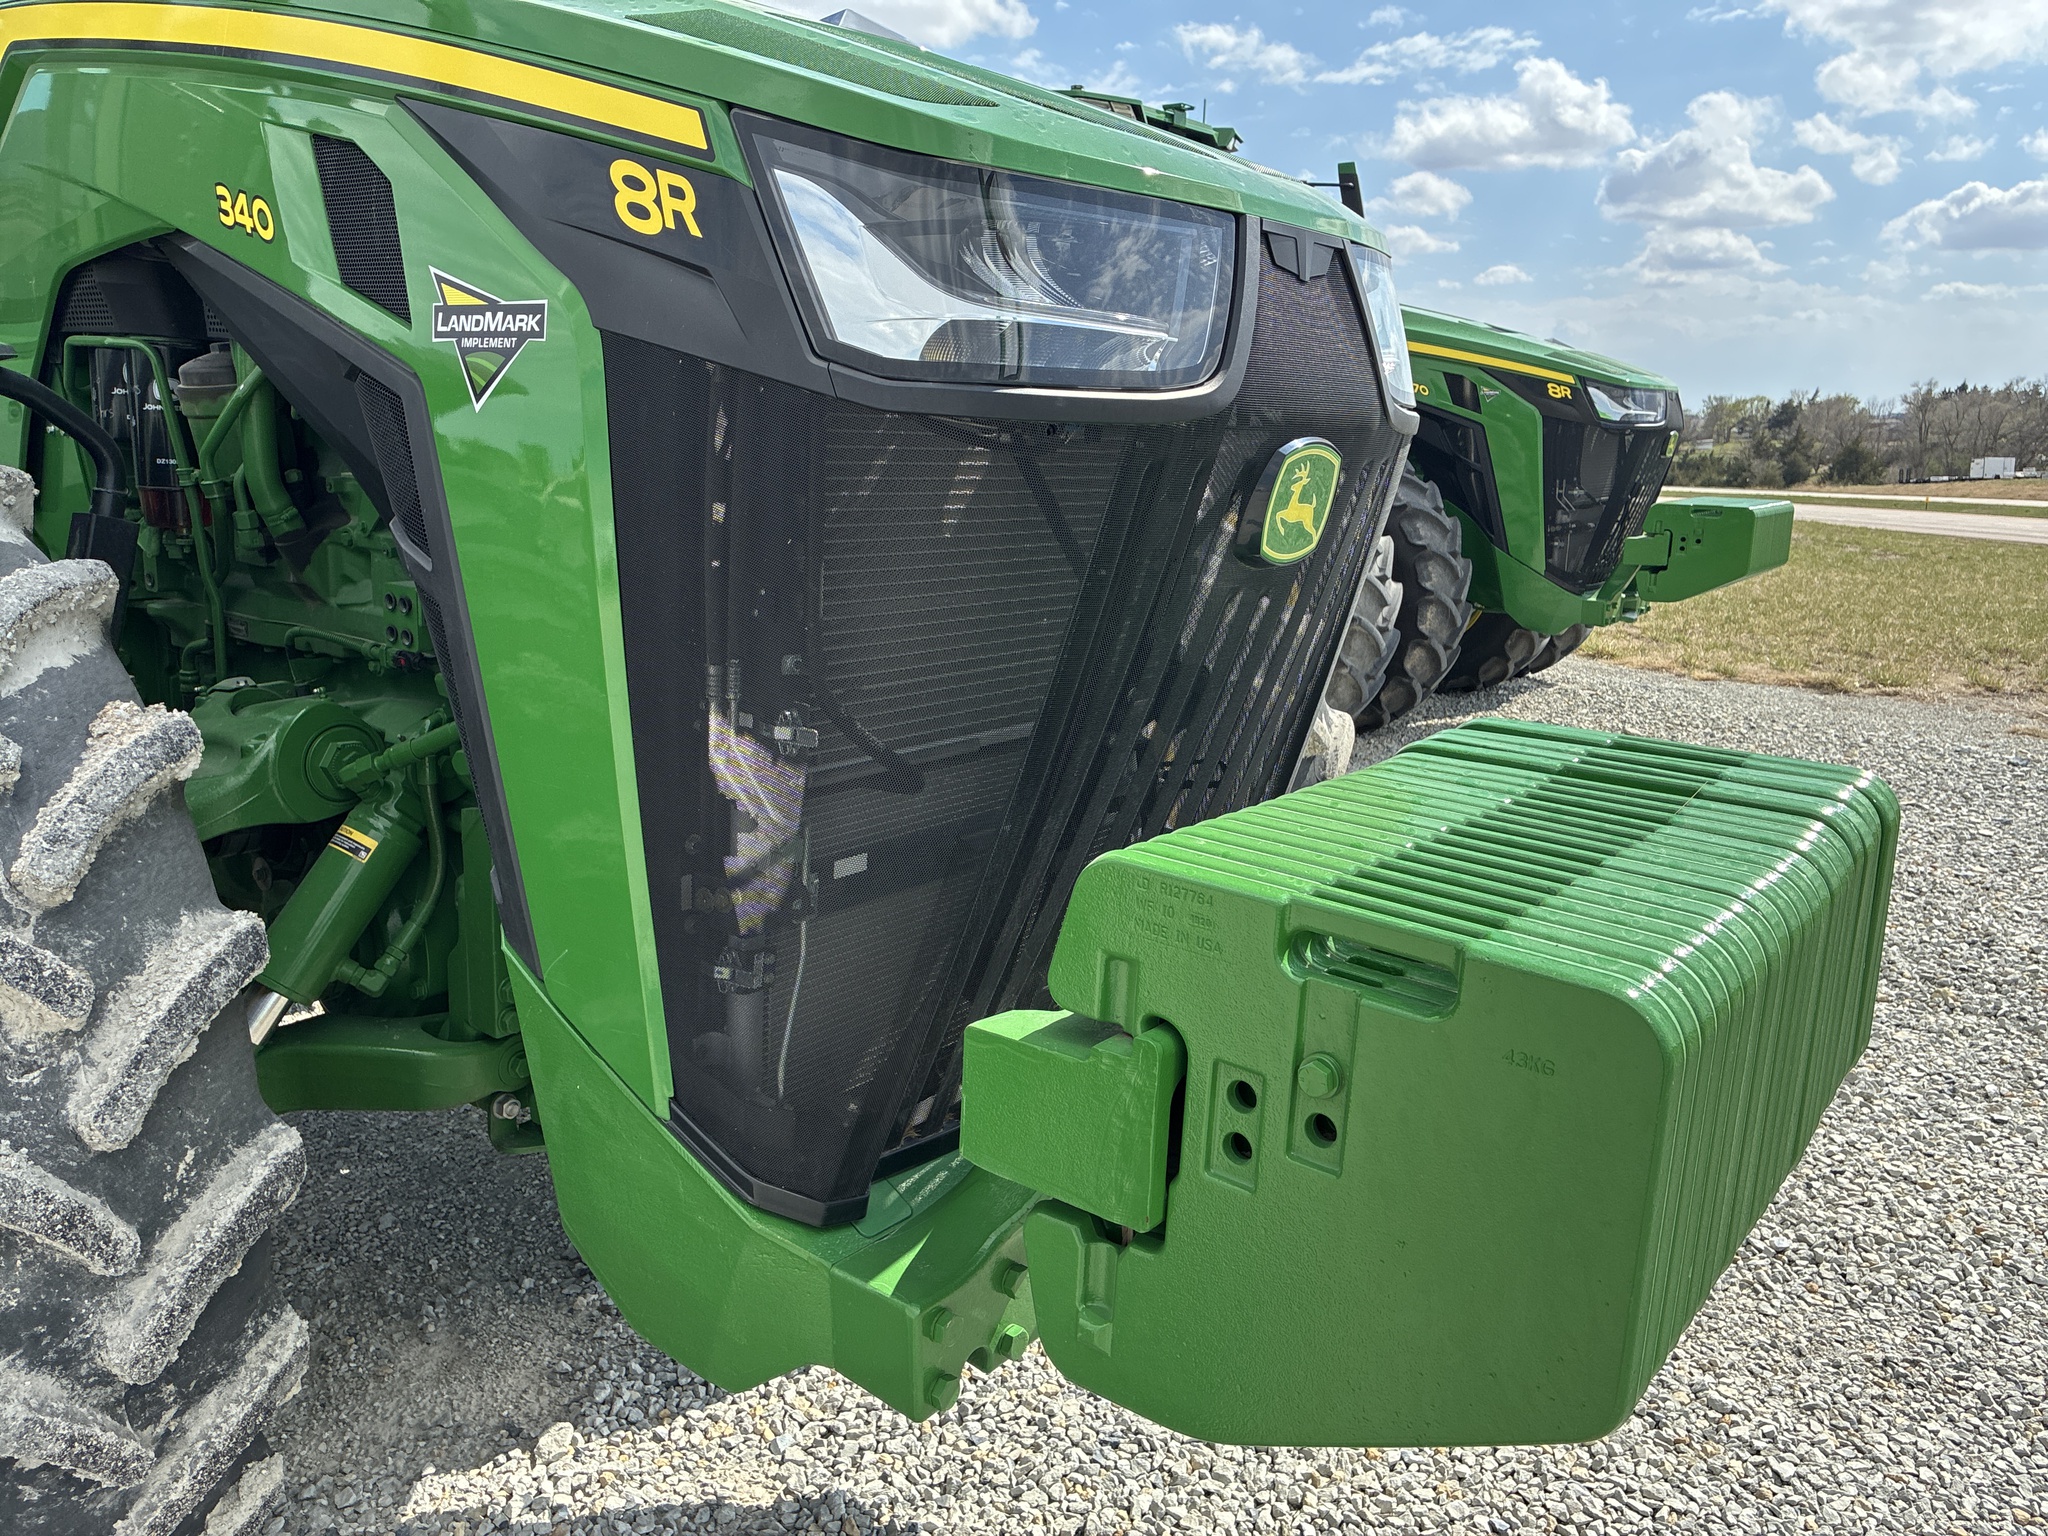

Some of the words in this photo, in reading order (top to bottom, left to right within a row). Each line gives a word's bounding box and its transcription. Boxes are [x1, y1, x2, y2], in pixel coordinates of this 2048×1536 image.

[609, 159, 703, 238] 8R
[215, 183, 275, 243] 340
[461, 337, 518, 348] IMPLEMENT
[111, 387, 129, 395] JOH
[1413, 383, 1430, 396] 70
[1547, 382, 1573, 400] 8R
[1135, 916, 1169, 940] MADE
[1177, 929, 1190, 944] IN
[1502, 1048, 1556, 1077] 43KG
